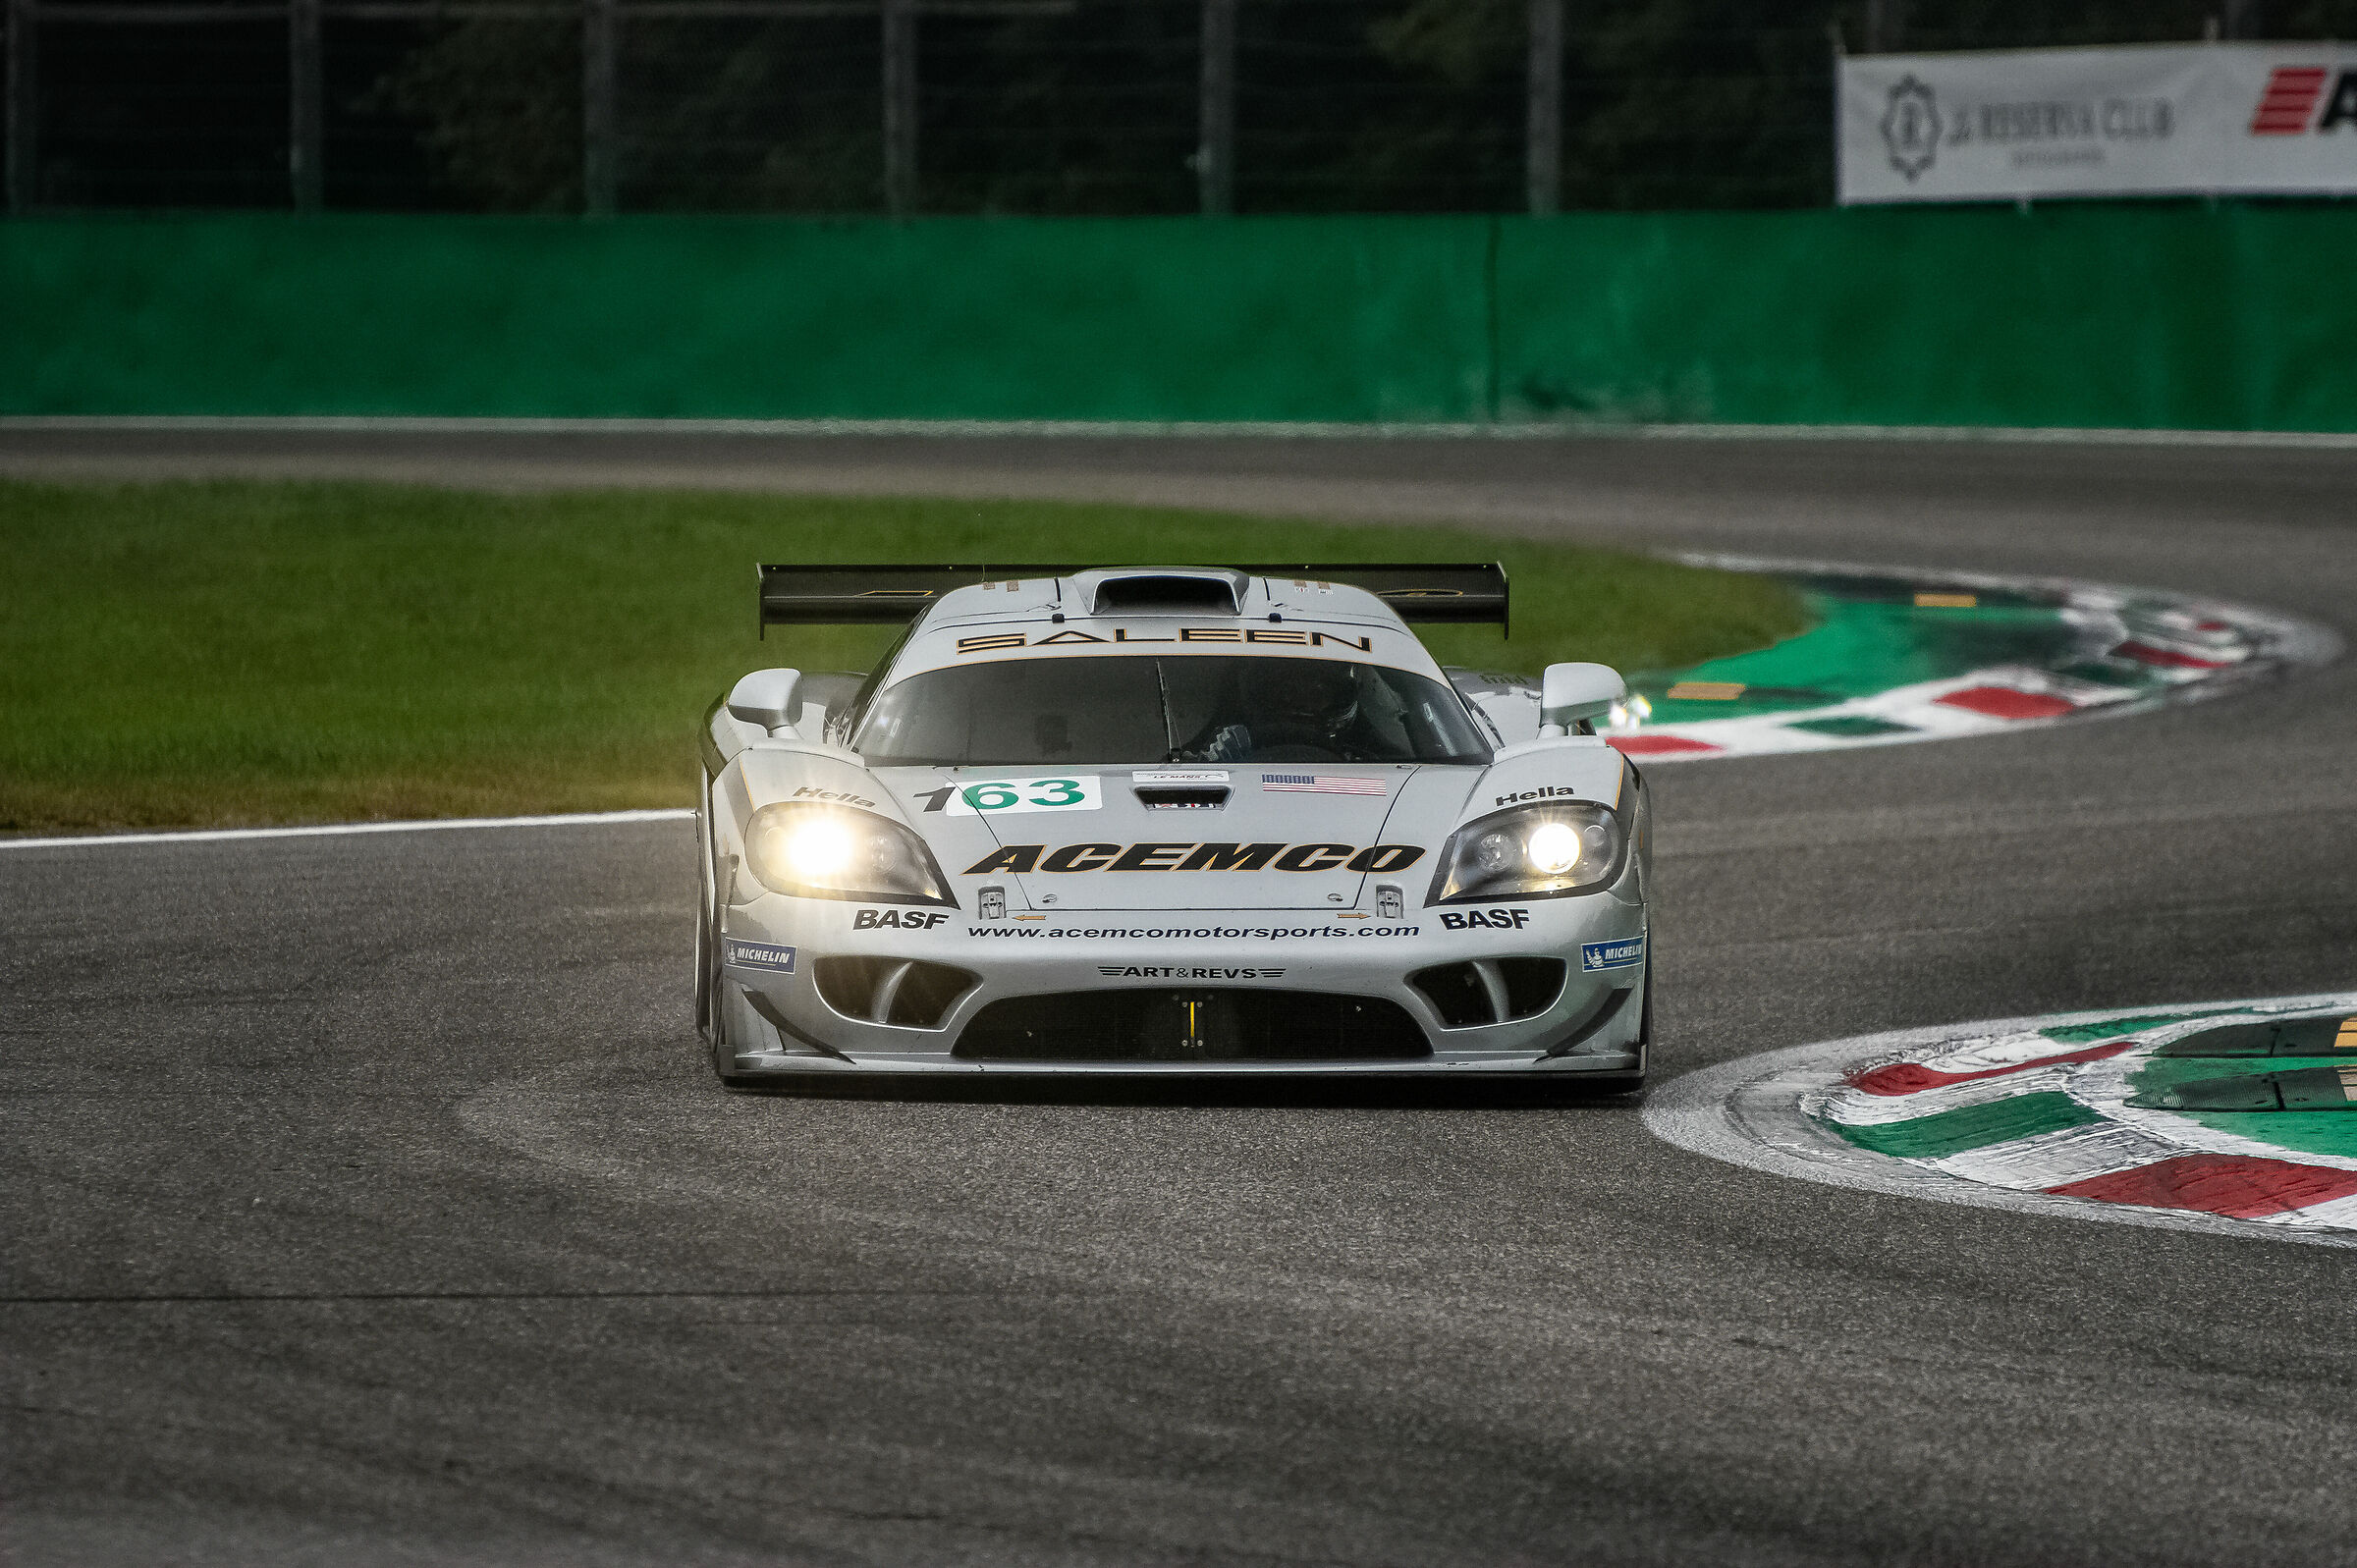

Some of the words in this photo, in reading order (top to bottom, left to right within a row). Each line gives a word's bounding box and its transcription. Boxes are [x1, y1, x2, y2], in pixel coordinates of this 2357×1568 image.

[958, 628, 1372, 654] SALEEN
[793, 786, 876, 808] Hella
[1496, 786, 1574, 806] Hella
[961, 842, 1426, 874] ACEMCO
[852, 909, 950, 931] BASF
[1440, 908, 1530, 930] BASF
[967, 924, 1420, 940] www.acemcomotorsports.com
[737, 947, 790, 963] MICHELIN
[1605, 945, 1642, 959] MICHELIN
